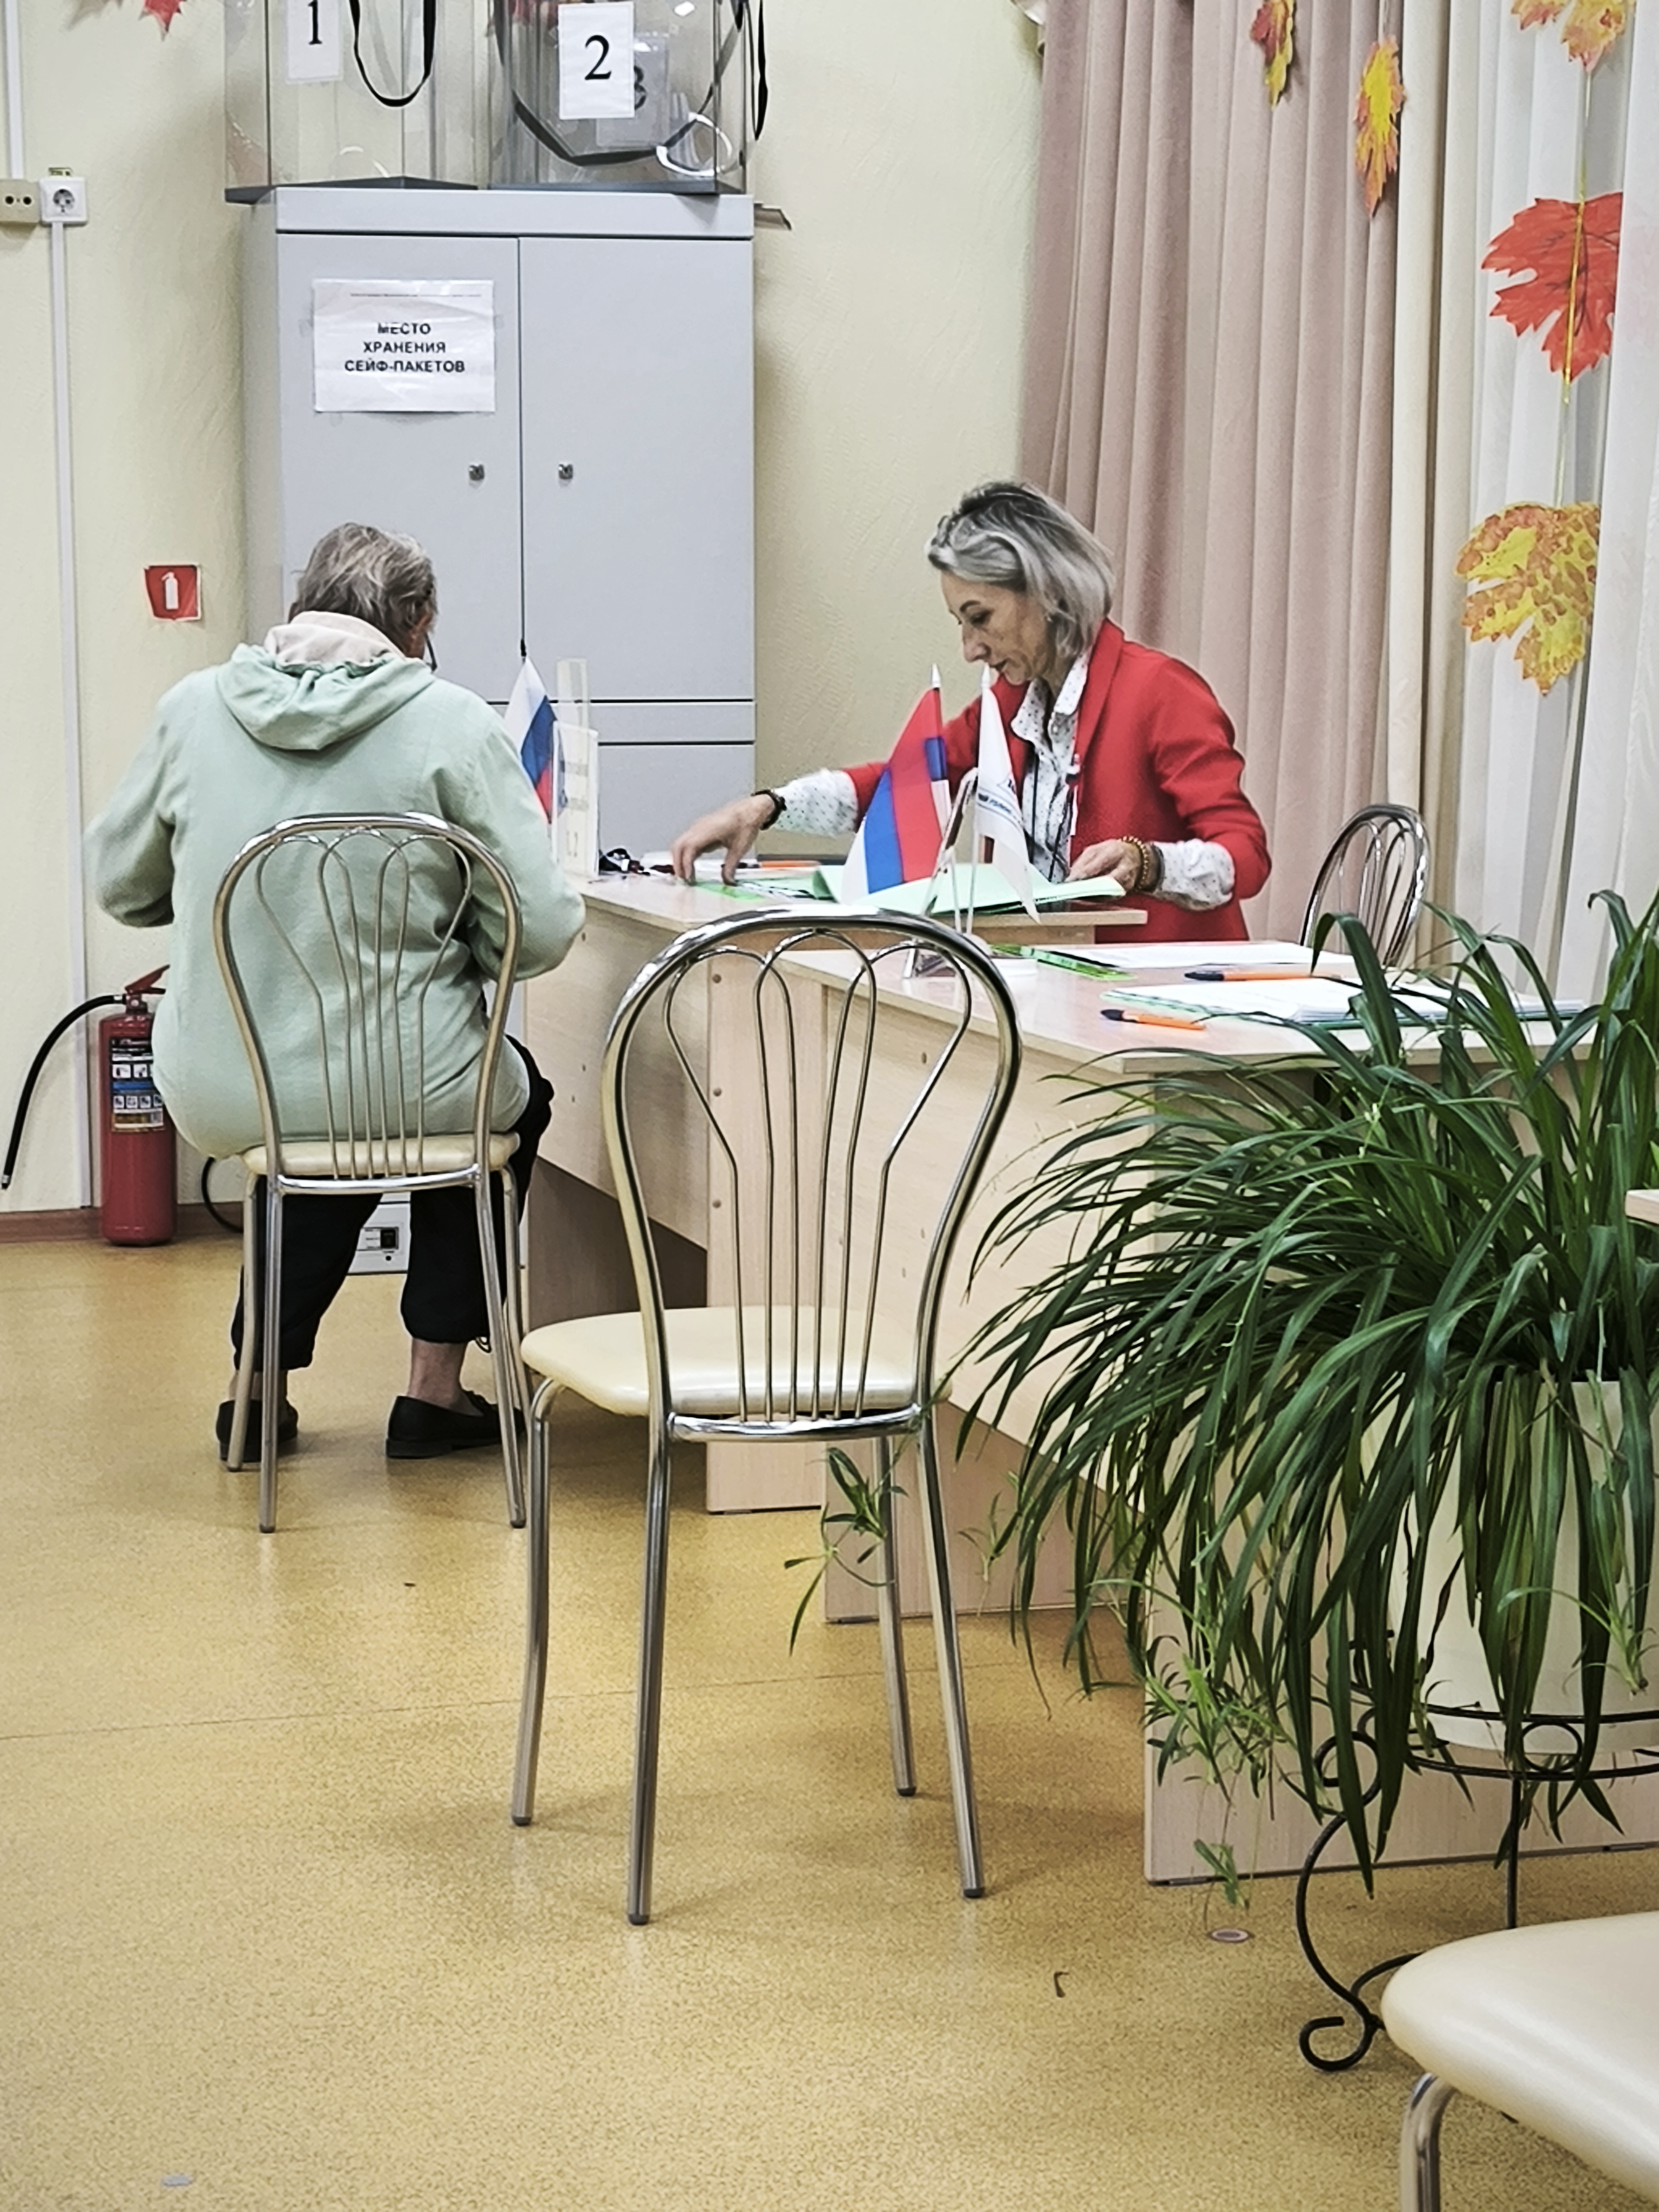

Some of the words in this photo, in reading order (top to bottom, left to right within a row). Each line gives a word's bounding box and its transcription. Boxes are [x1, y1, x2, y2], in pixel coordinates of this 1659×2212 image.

[308, 0, 322, 45] 1
[584, 34, 612, 80] 2
[377, 322, 431, 335] МЕСТО
[363, 341, 446, 353] ХРАНЕНИЯ
[345, 358, 465, 373] СЕЙФ-ПАКЕТОВ
